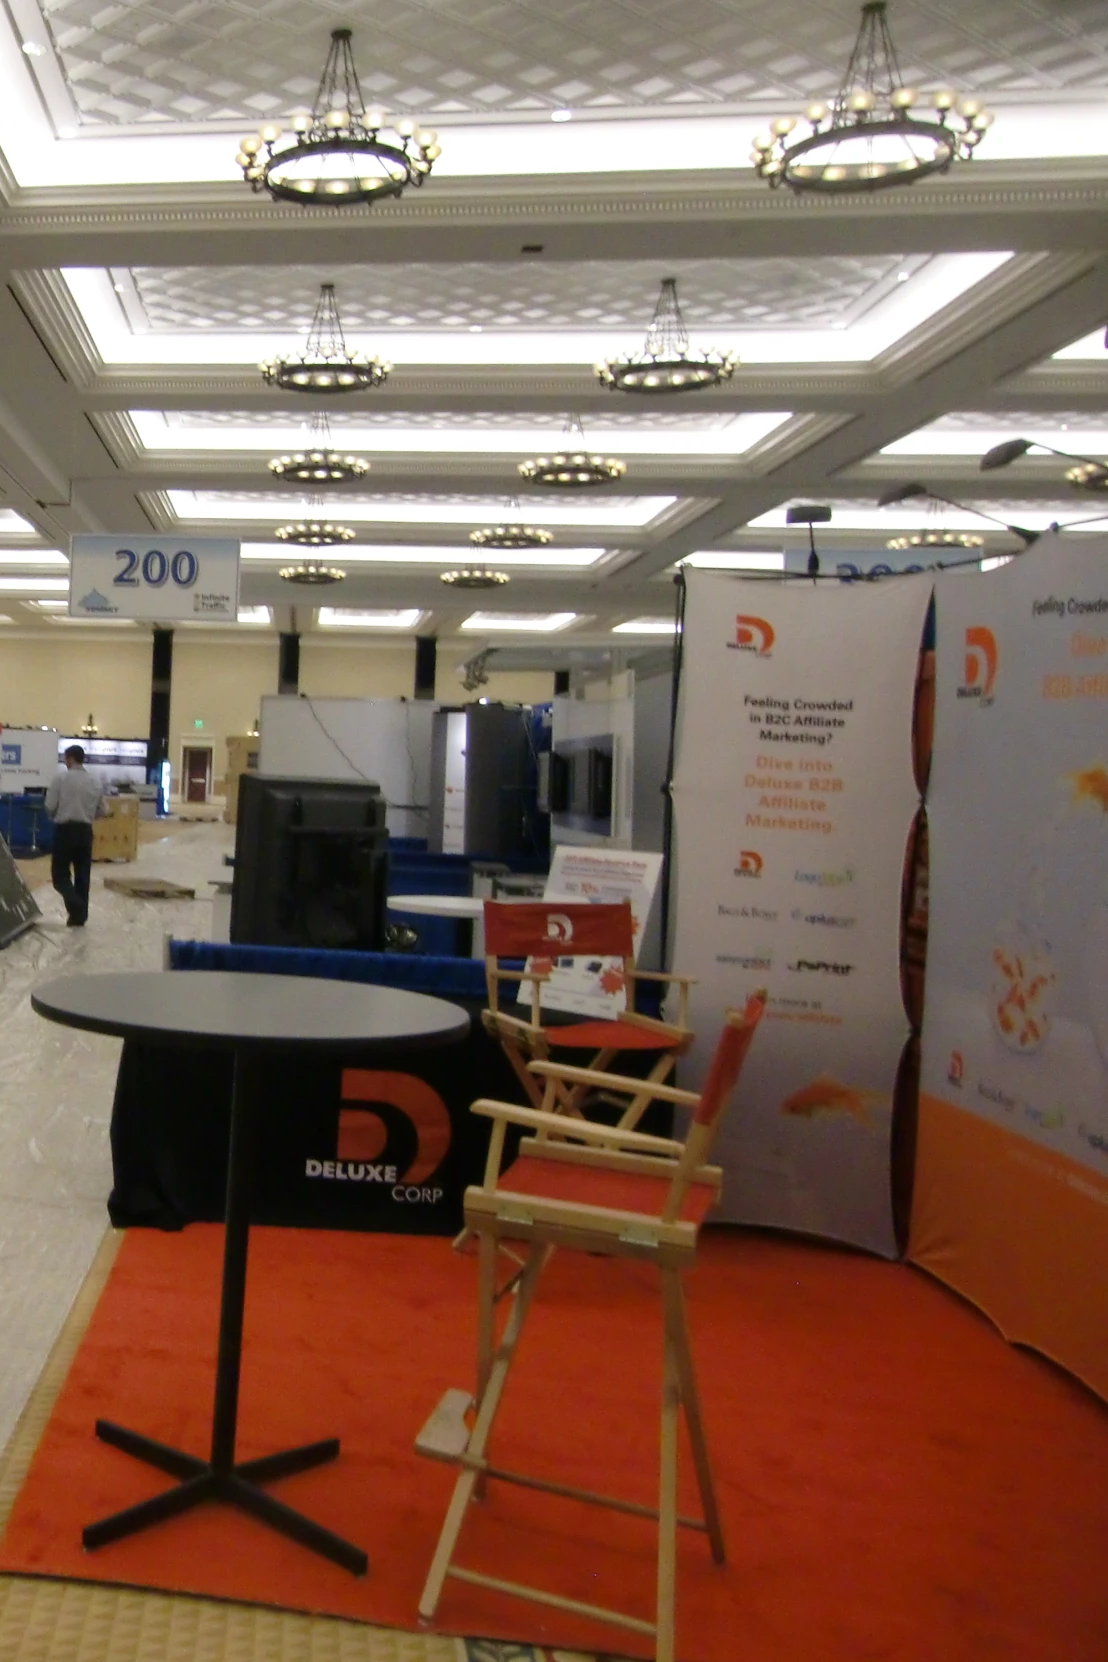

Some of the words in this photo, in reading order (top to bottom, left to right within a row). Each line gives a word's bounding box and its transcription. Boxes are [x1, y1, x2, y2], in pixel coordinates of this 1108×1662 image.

[113, 549, 199, 588] 200
[744, 695, 790, 711] Feeling
[794, 699, 854, 711] Crowded
[750, 713, 761, 724] in
[765, 714, 791, 725] B2C
[794, 715, 846, 728] Affiliate
[760, 730, 834, 746] Marketing?
[756, 756, 793, 771] Dive
[799, 758, 833, 772] into
[744, 774, 803, 790] Deluxe
[809, 777, 844, 792] B2B
[760, 796, 827, 811] Affiliate
[306, 1159, 397, 1183] DELUXE
[392, 1185, 443, 1203] CORP
